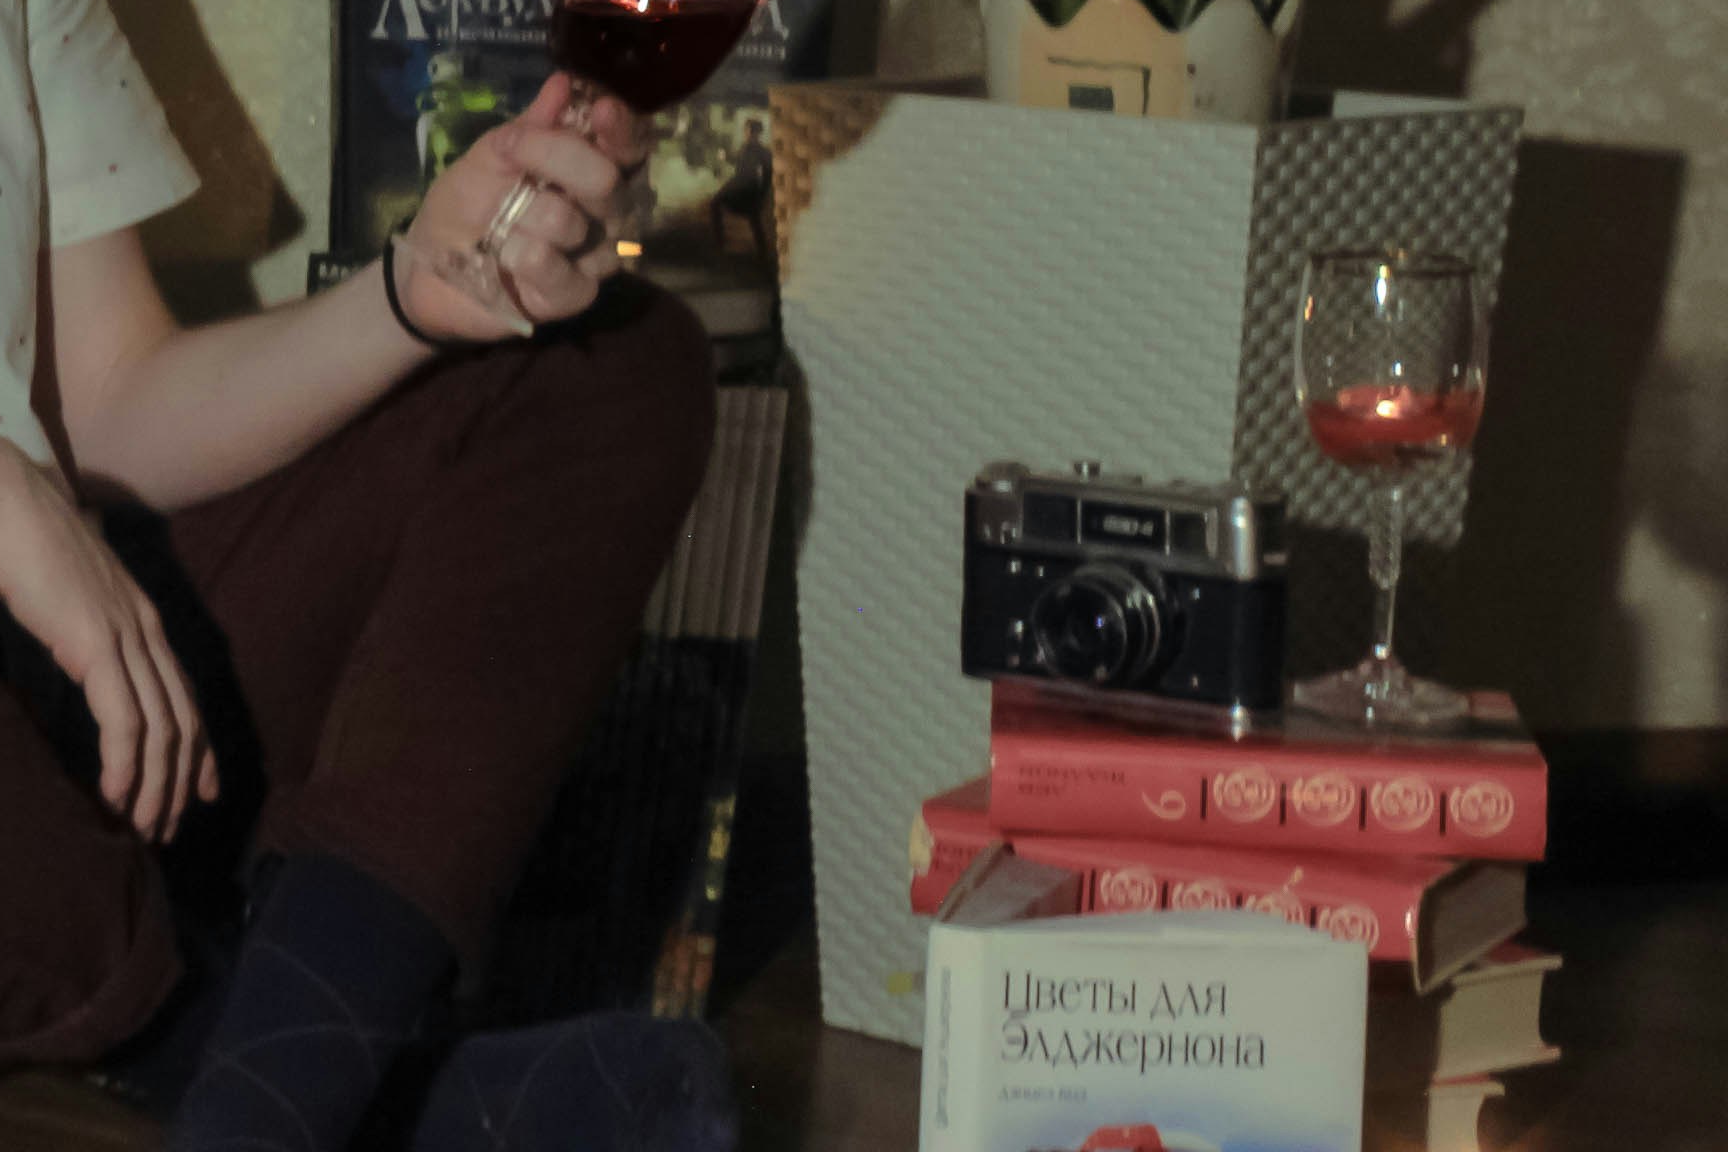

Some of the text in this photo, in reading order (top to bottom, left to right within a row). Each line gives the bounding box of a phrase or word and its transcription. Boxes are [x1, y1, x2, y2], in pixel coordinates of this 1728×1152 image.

[1002, 969, 1228, 1020] Цветы для
[1001, 1017, 1266, 1075] Элджернона
